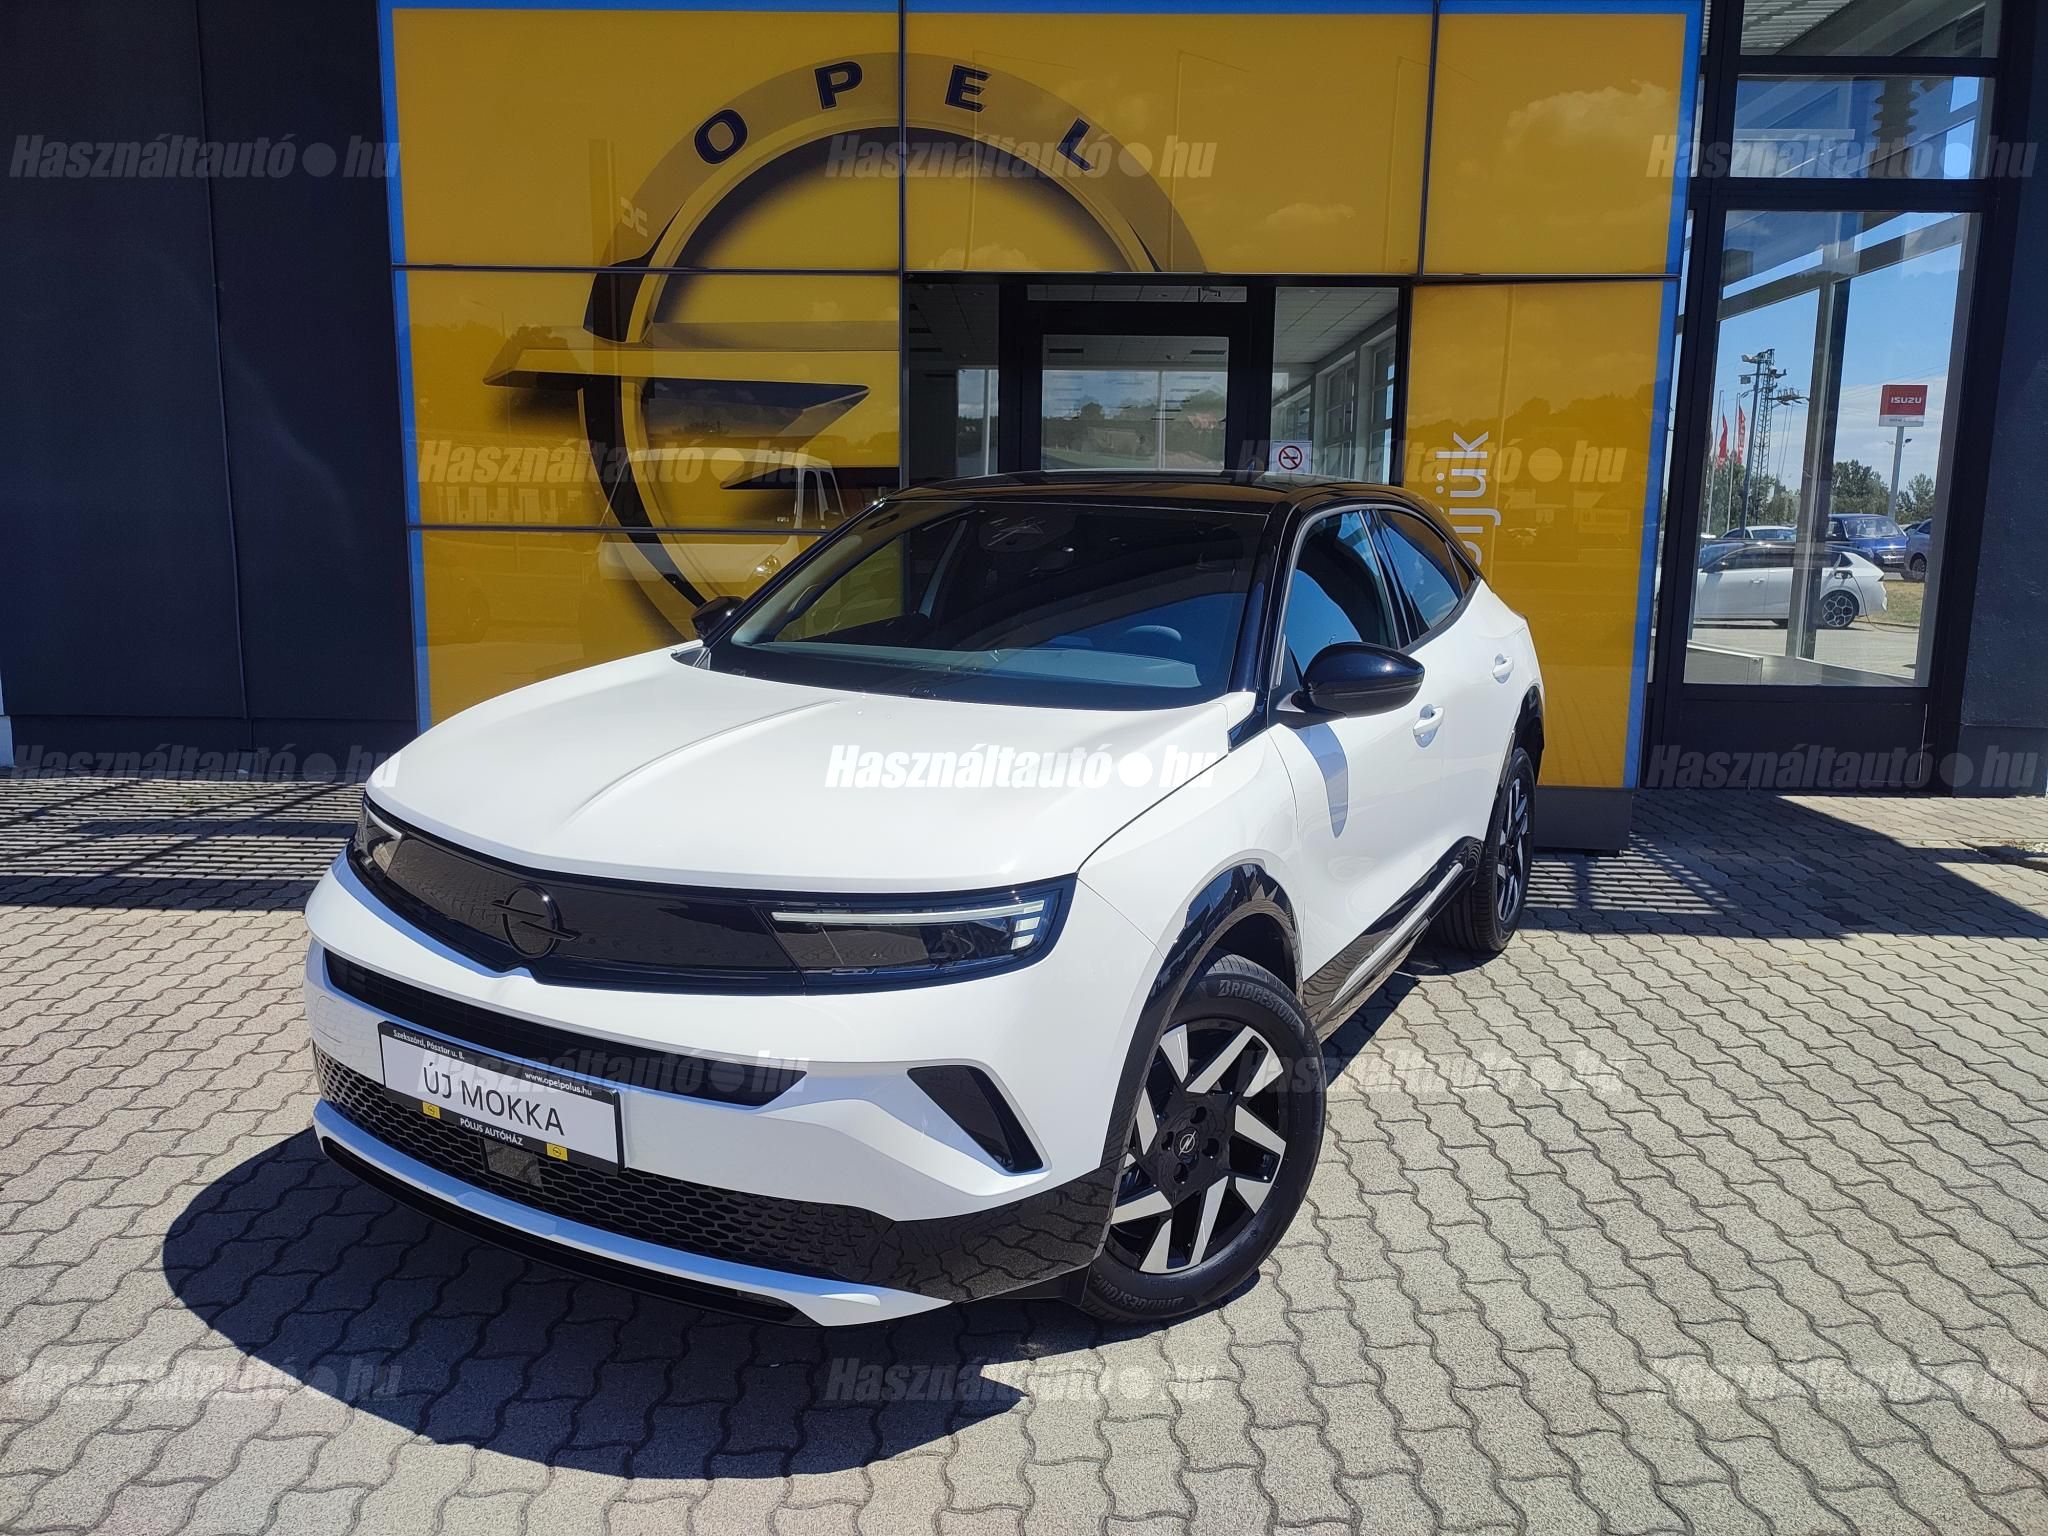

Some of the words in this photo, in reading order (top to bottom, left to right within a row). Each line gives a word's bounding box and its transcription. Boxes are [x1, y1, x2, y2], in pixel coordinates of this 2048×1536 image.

[694, 61, 1095, 172] OPEL
[1890, 396, 1922, 404] ISUZU
[423, 1061, 452, 1099] ÚJ
[461, 1079, 565, 1136] MOKKA
[524, 1072, 593, 1096] www.opelpolus.hu
[460, 1117, 484, 1133] PÓLUS
[484, 1126, 524, 1146] AUTÓHÁZ
